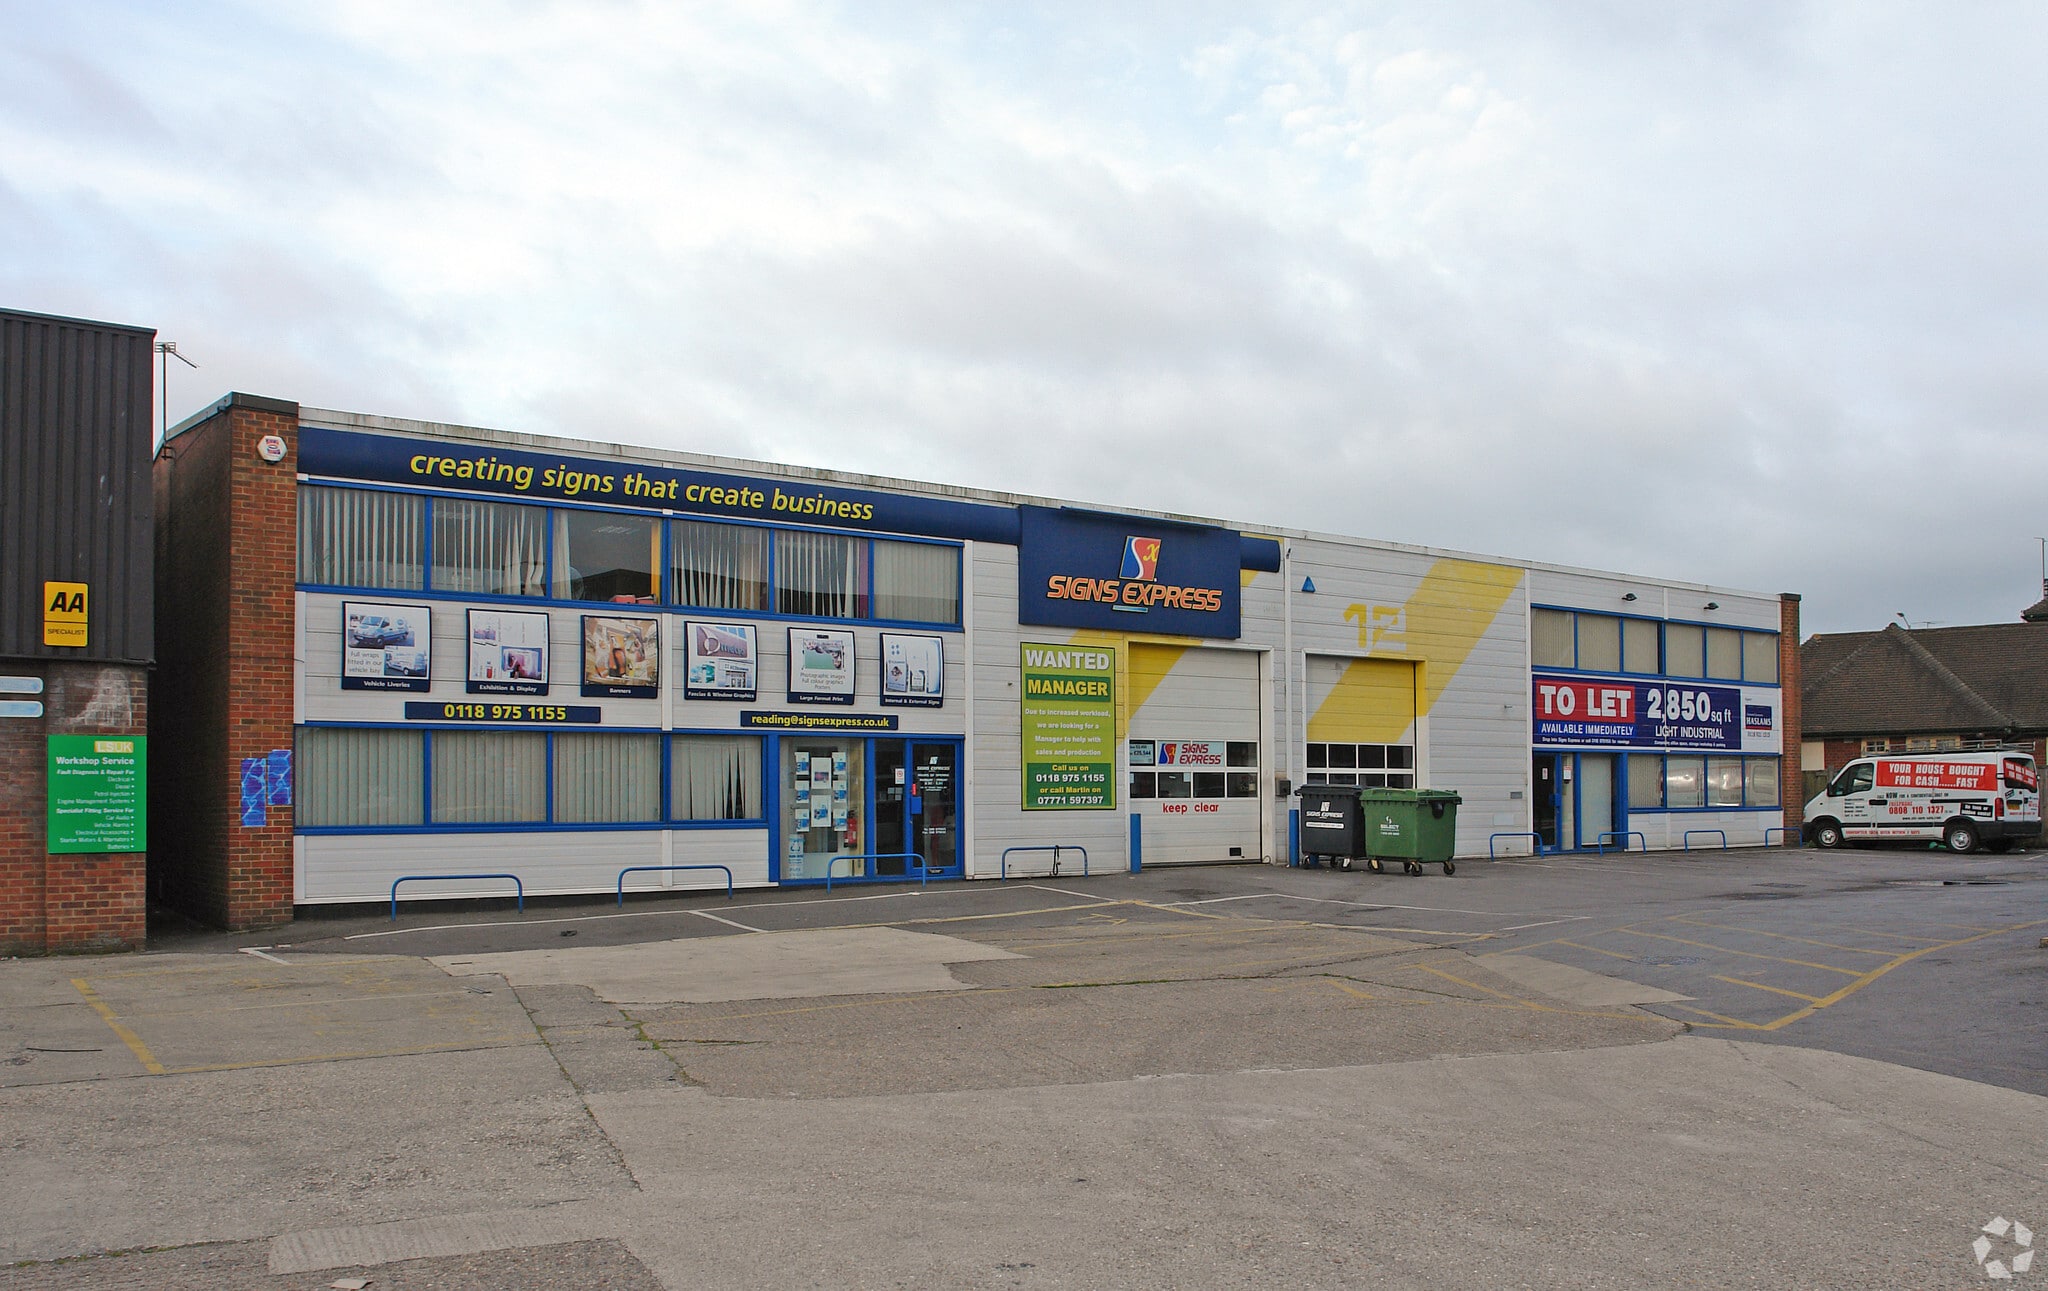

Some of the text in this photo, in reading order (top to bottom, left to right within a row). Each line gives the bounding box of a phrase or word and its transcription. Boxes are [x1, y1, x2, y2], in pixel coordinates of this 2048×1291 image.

[410, 455, 873, 520] creating signs that create business
[1047, 575, 1222, 612] SIGNS EXPRESS
[50, 591, 84, 613] AA
[47, 628, 85, 636] SPECIALIST
[1025, 650, 1110, 670] WANTED
[1028, 679, 1108, 696] MANAGER
[1540, 685, 1631, 717] TO LET
[1647, 688, 1732, 725] 2,850 sq ft
[444, 704, 566, 721] 0118 975 1155
[751, 715, 889, 727] reading@signsexpress.co.uk
[1060, 722, 1084, 730] looking
[1747, 717, 1771, 725] HASLAMS
[1541, 723, 1634, 735] AVAILABLE IMMEDIATELY
[1656, 725, 1724, 739] LIGHT INDUSTRIAL
[1181, 744, 1208, 753] SIGNS
[56, 756, 135, 766] Workshop Service
[1180, 755, 1221, 764] EXPRESS
[1889, 764, 1985, 776] YOUR HOUSE BOUGHT
[1036, 774, 1105, 782] 0118 975 1155
[1895, 776, 1910, 785] FOR
[1037, 796, 1104, 804] 07771 597397
[1163, 803, 1219, 814] keep clear
[1912, 806, 1923, 814] 110
